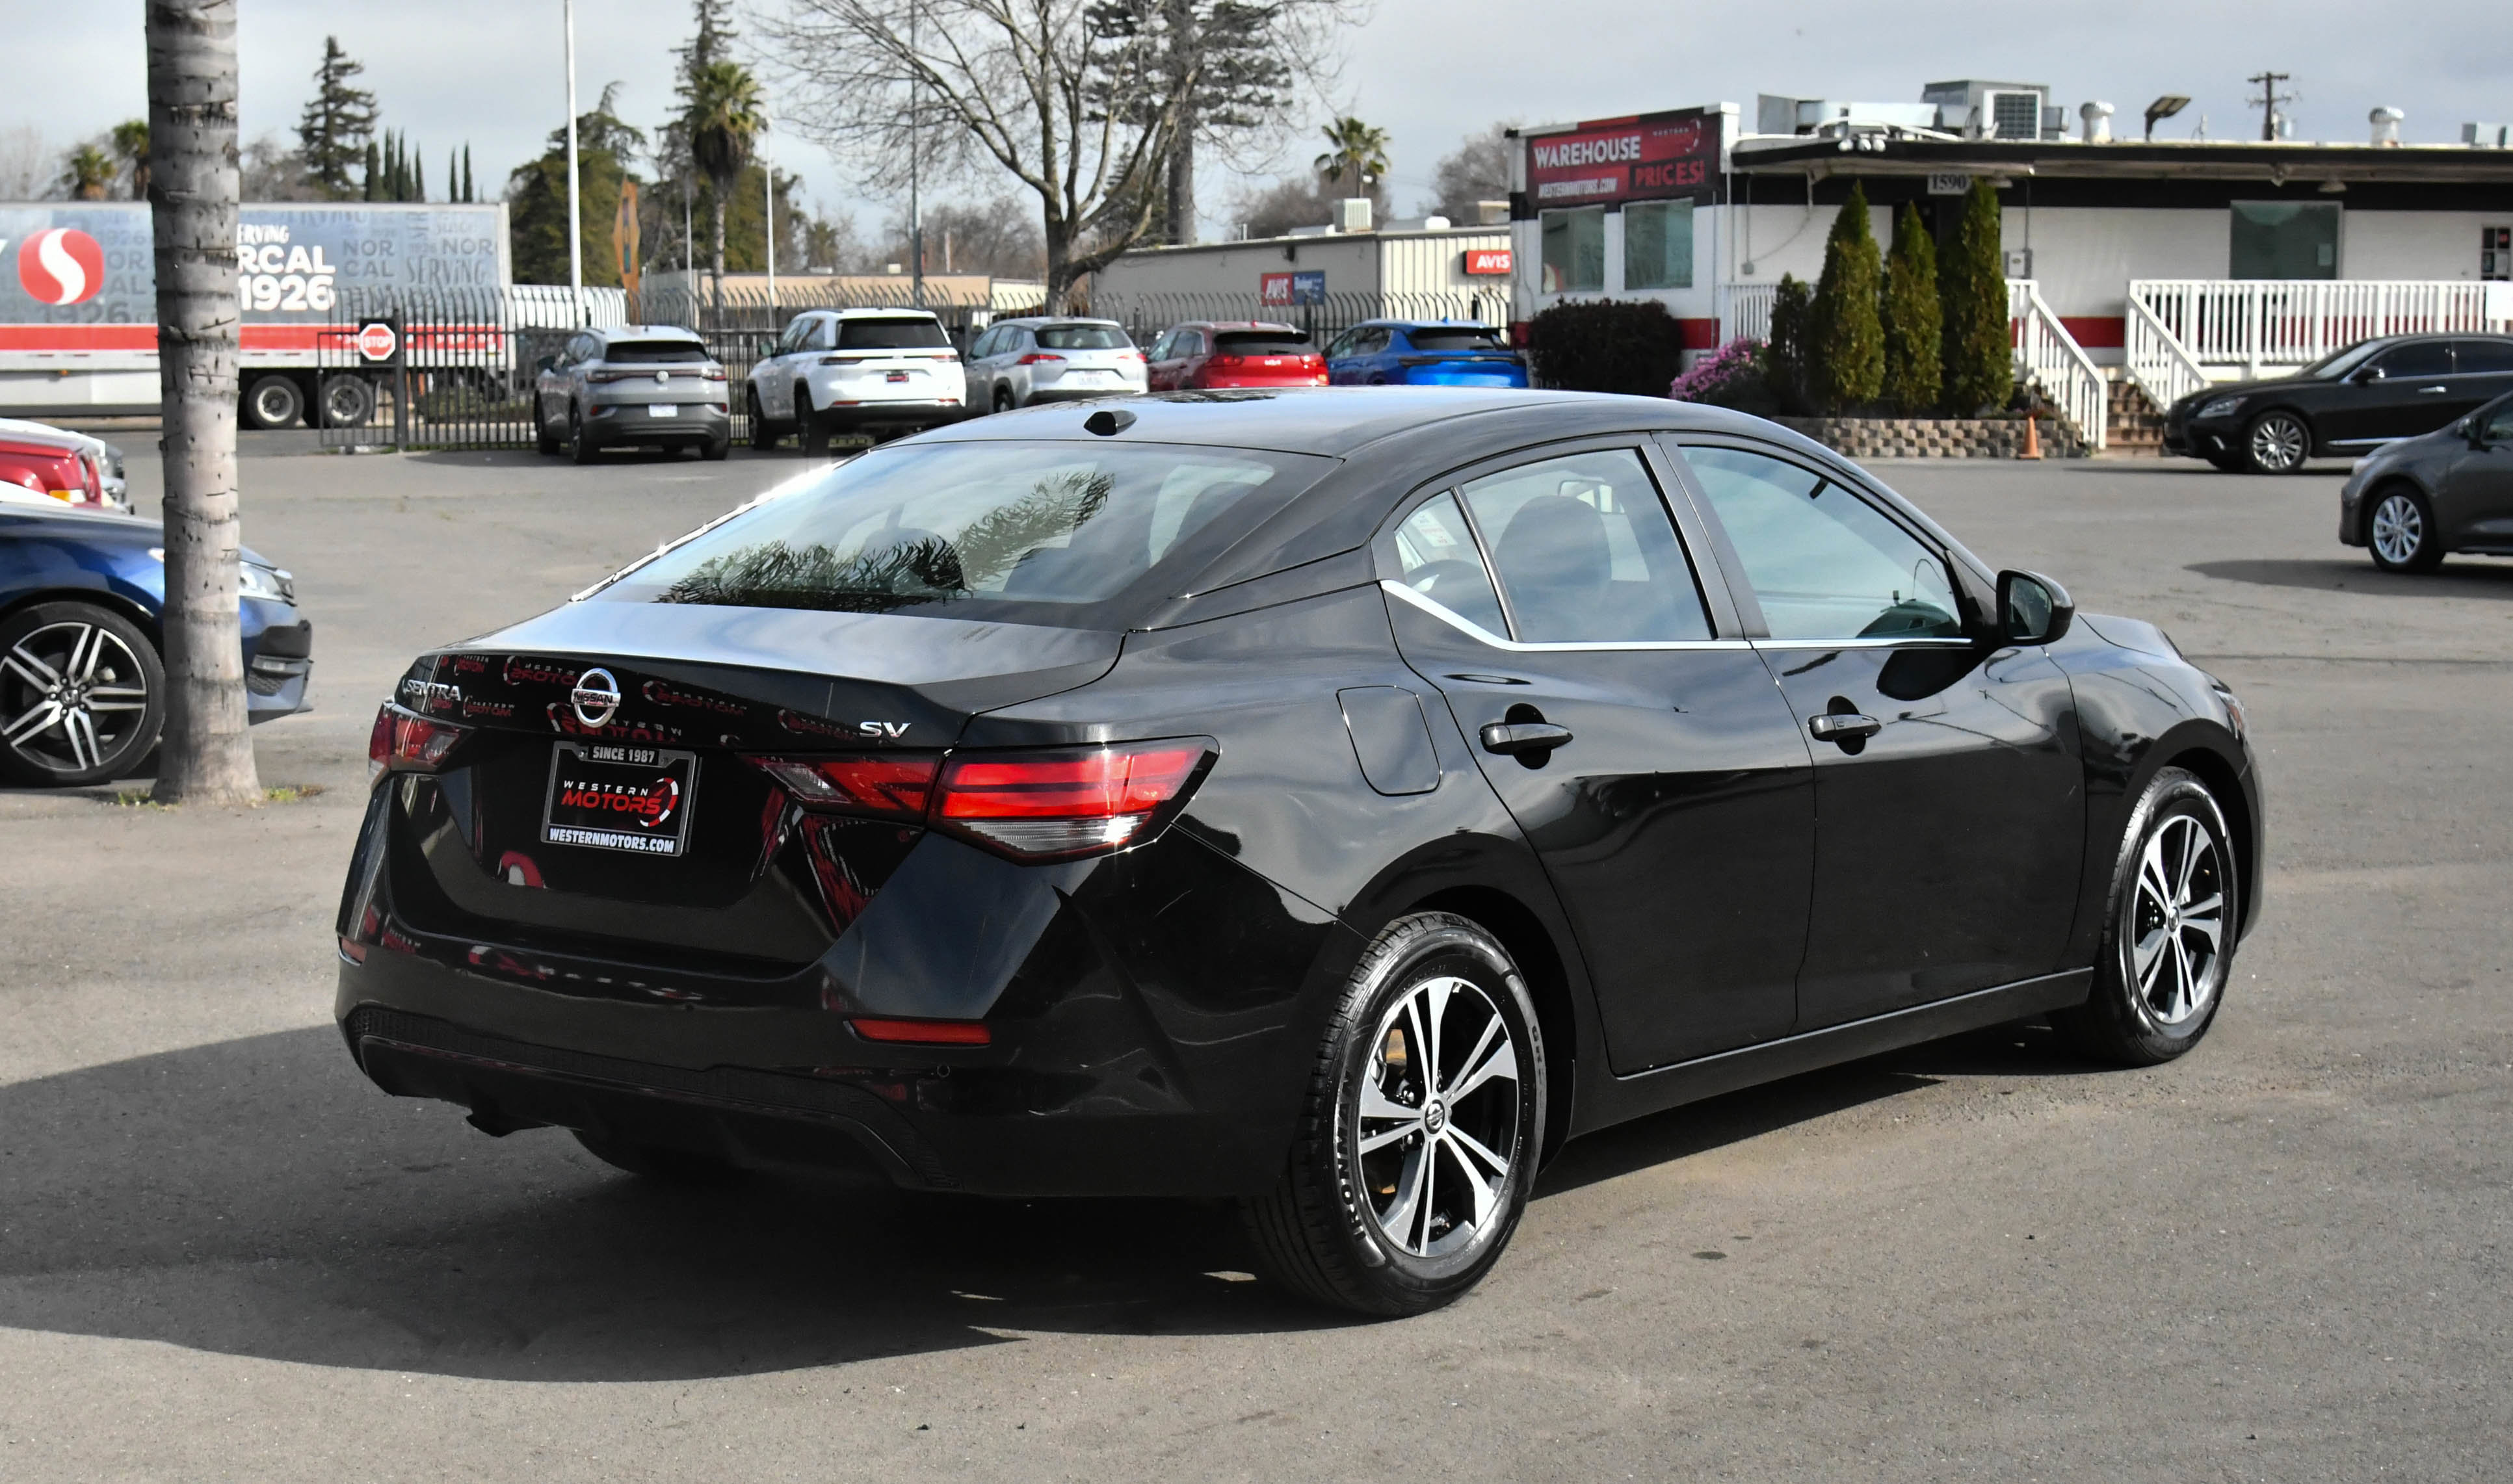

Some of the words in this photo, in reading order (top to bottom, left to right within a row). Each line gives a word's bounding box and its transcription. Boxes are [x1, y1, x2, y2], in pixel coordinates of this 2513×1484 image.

[1534, 135, 1642, 168] WAREHOUSE
[1635, 160, 1706, 187] PRICES!
[1932, 173, 1968, 190] 1590
[237, 223, 289, 245] ERVING
[343, 239, 395, 256] NOR
[106, 250, 147, 271] OR
[237, 244, 336, 274] RCAL
[343, 259, 395, 278] CAL
[1476, 254, 1510, 268] AVIS
[109, 275, 147, 295] AL
[238, 274, 336, 311] 1926
[363, 335, 391, 349] STOP
[407, 679, 462, 702] SENTRA
[573, 691, 614, 704] NISSAN
[860, 722, 911, 738] SV
[592, 746, 625, 761] SINCE
[628, 749, 655, 762] 1987
[564, 780, 649, 796] WESTERN
[561, 789, 662, 814] MOTORS
[549, 827, 675, 853] WESTERNMOTORS.COM
[1335, 1069, 1367, 1241] IRONMAN
